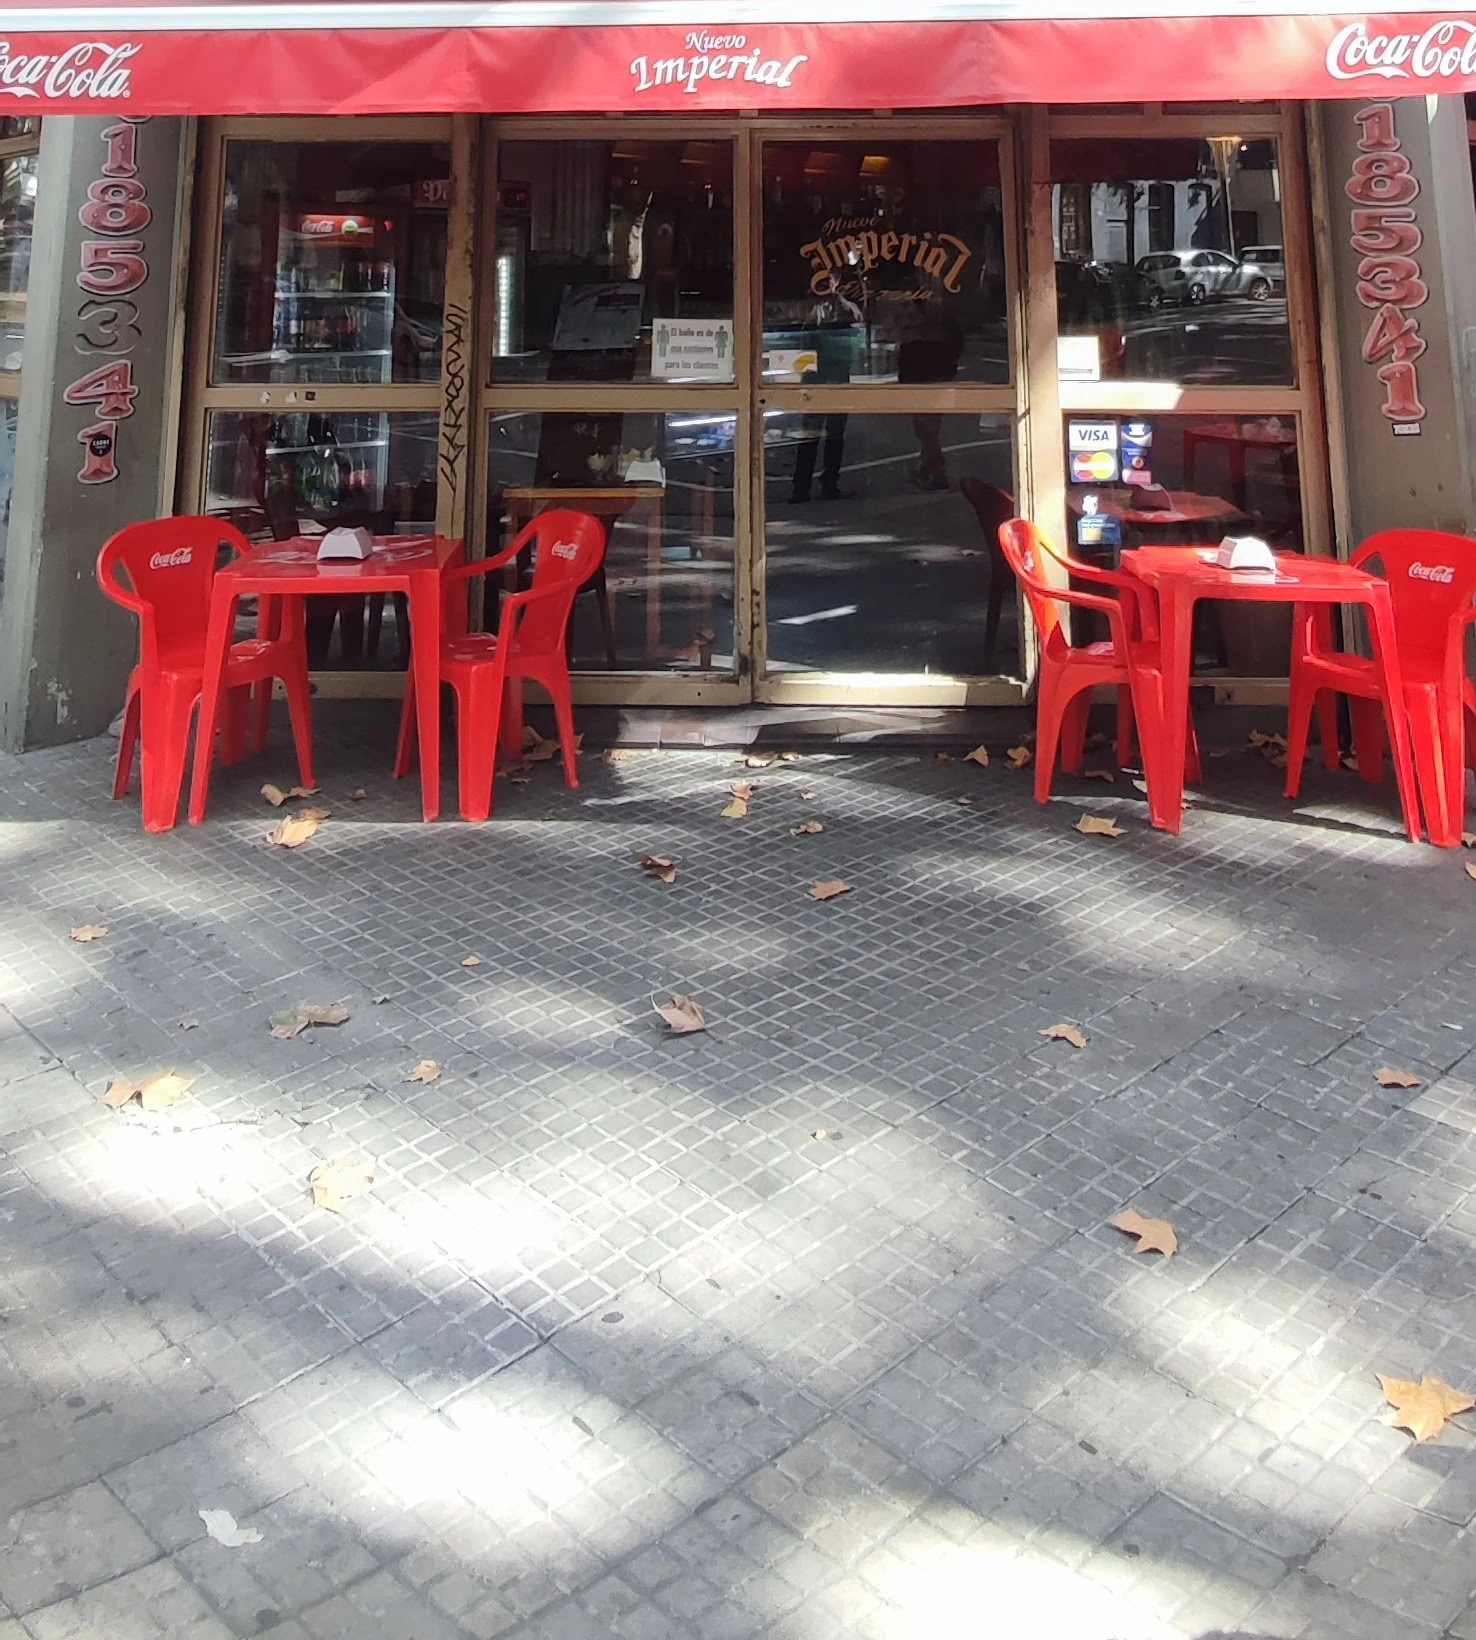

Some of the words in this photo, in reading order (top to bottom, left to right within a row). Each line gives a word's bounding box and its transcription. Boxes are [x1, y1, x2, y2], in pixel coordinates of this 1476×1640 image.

[685, 29, 747, 53] Nuevo
[1325, 20, 1476, 79] Coca-Col
[630, 48, 808, 94] Imperial
[800, 229, 972, 296] Imperial
[1344, 96, 1429, 421] 185341
[1078, 429, 1109, 441] VISA
